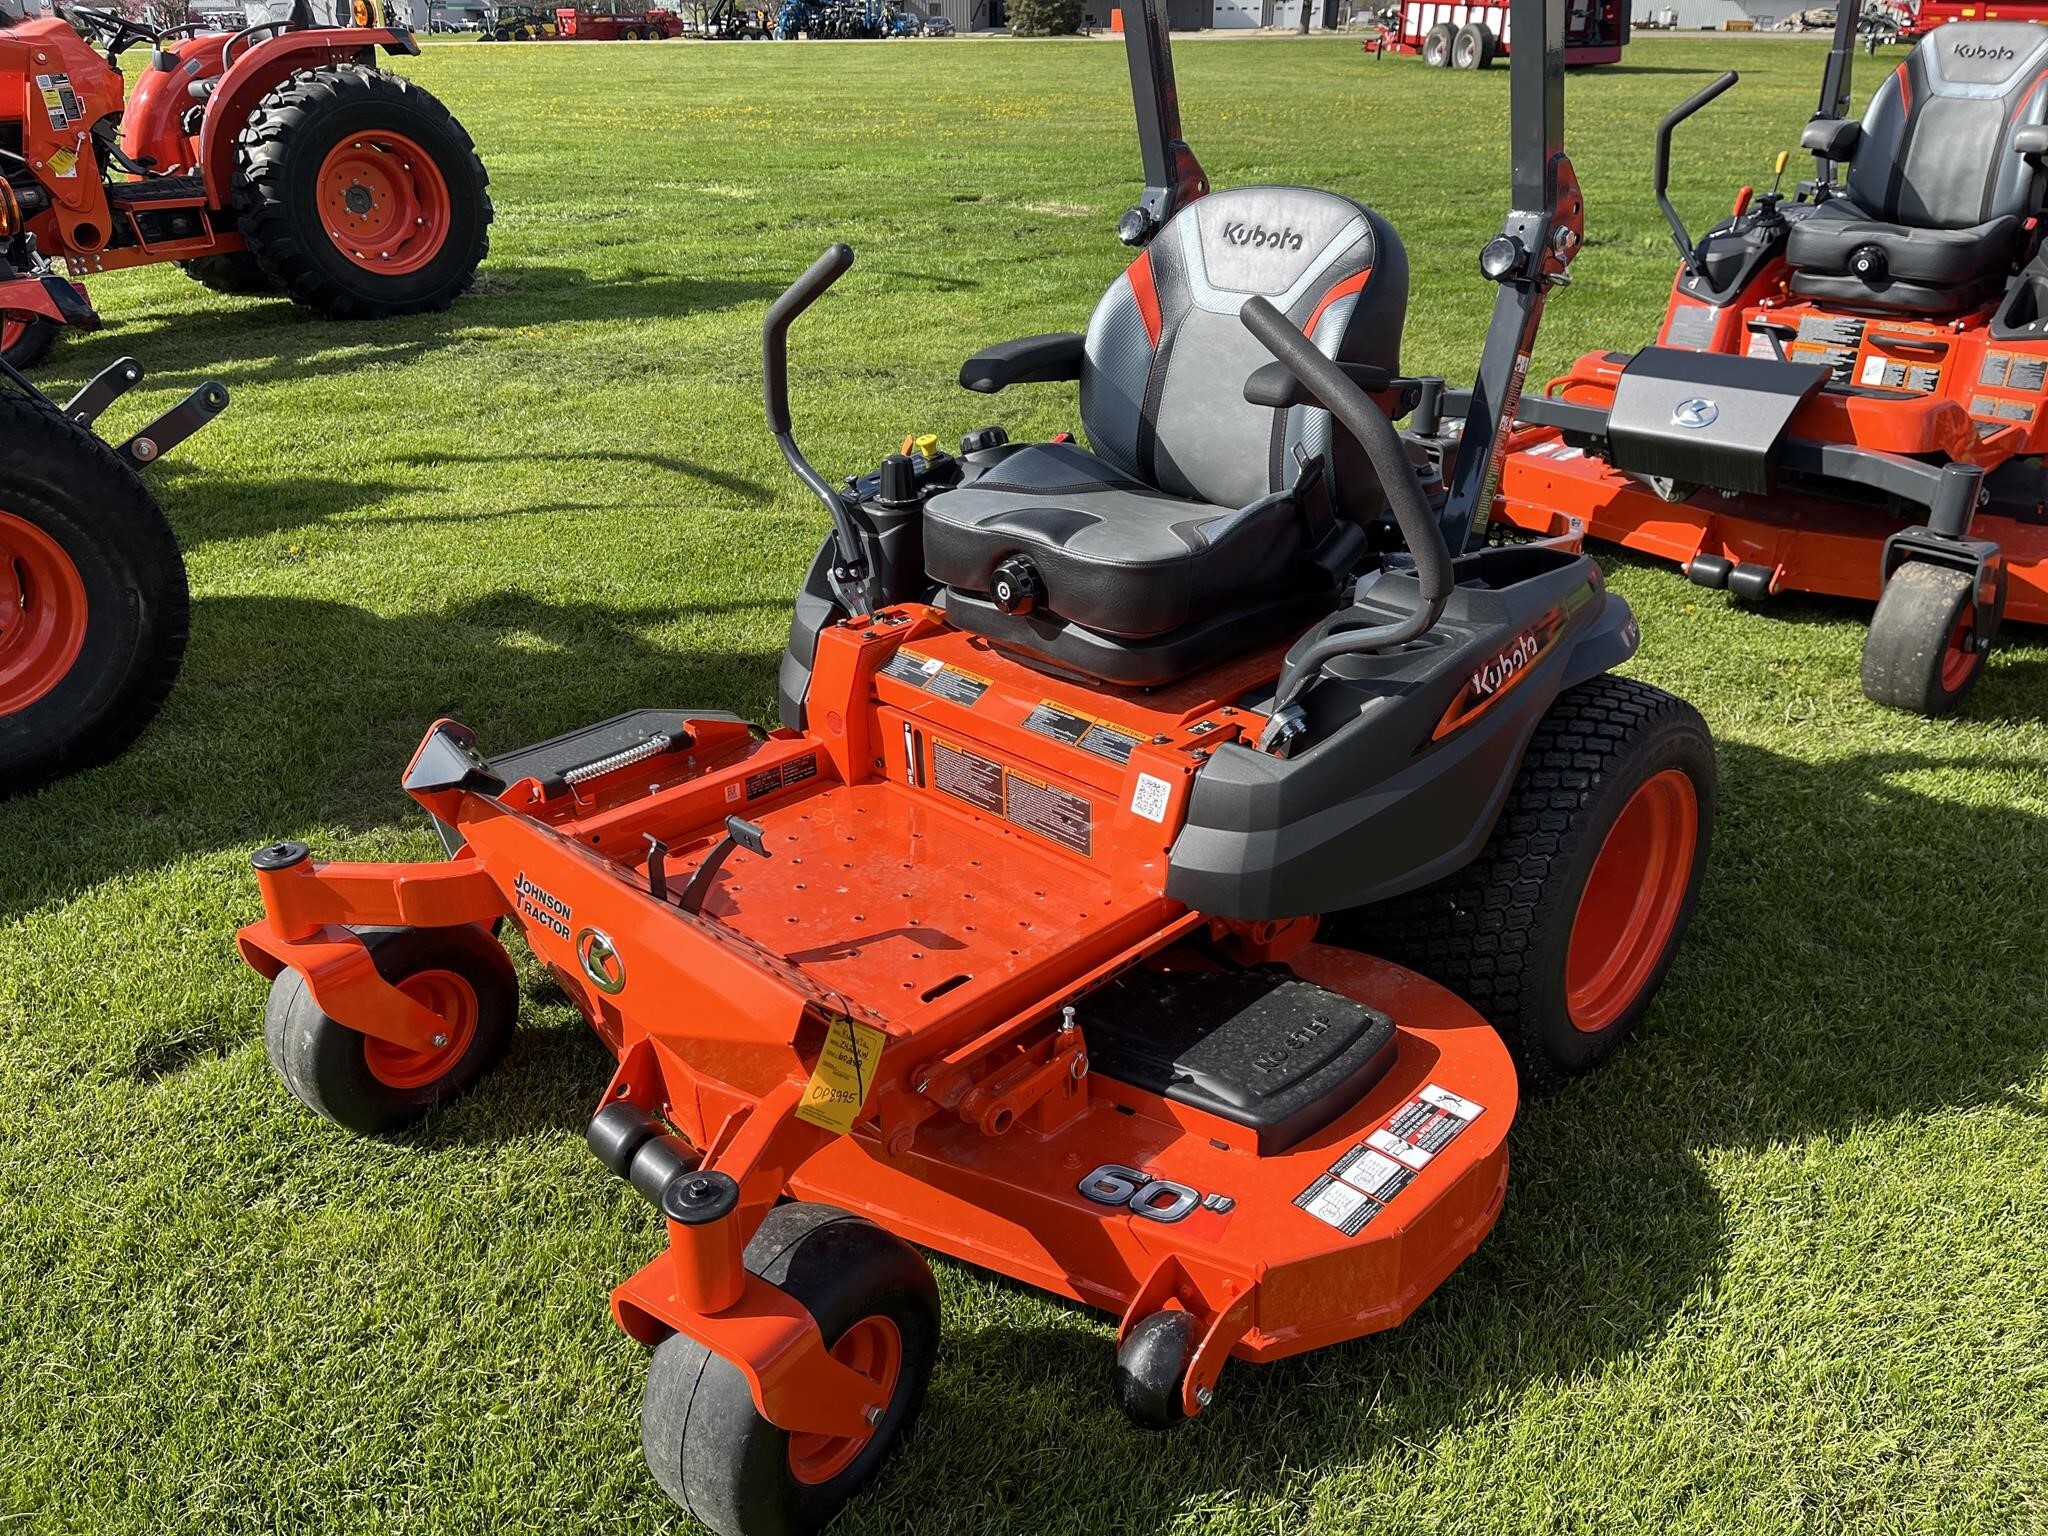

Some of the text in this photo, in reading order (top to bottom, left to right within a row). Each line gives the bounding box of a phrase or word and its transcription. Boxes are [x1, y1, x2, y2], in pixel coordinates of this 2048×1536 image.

[1954, 44, 2015, 60] Kubota
[1223, 221, 1303, 250] Kubota
[1471, 635, 1538, 694] Kubota
[514, 872, 571, 920] JOHNSON
[516, 889, 570, 940] TRACTOR
[1253, 1016, 1332, 1074] NO STEP
